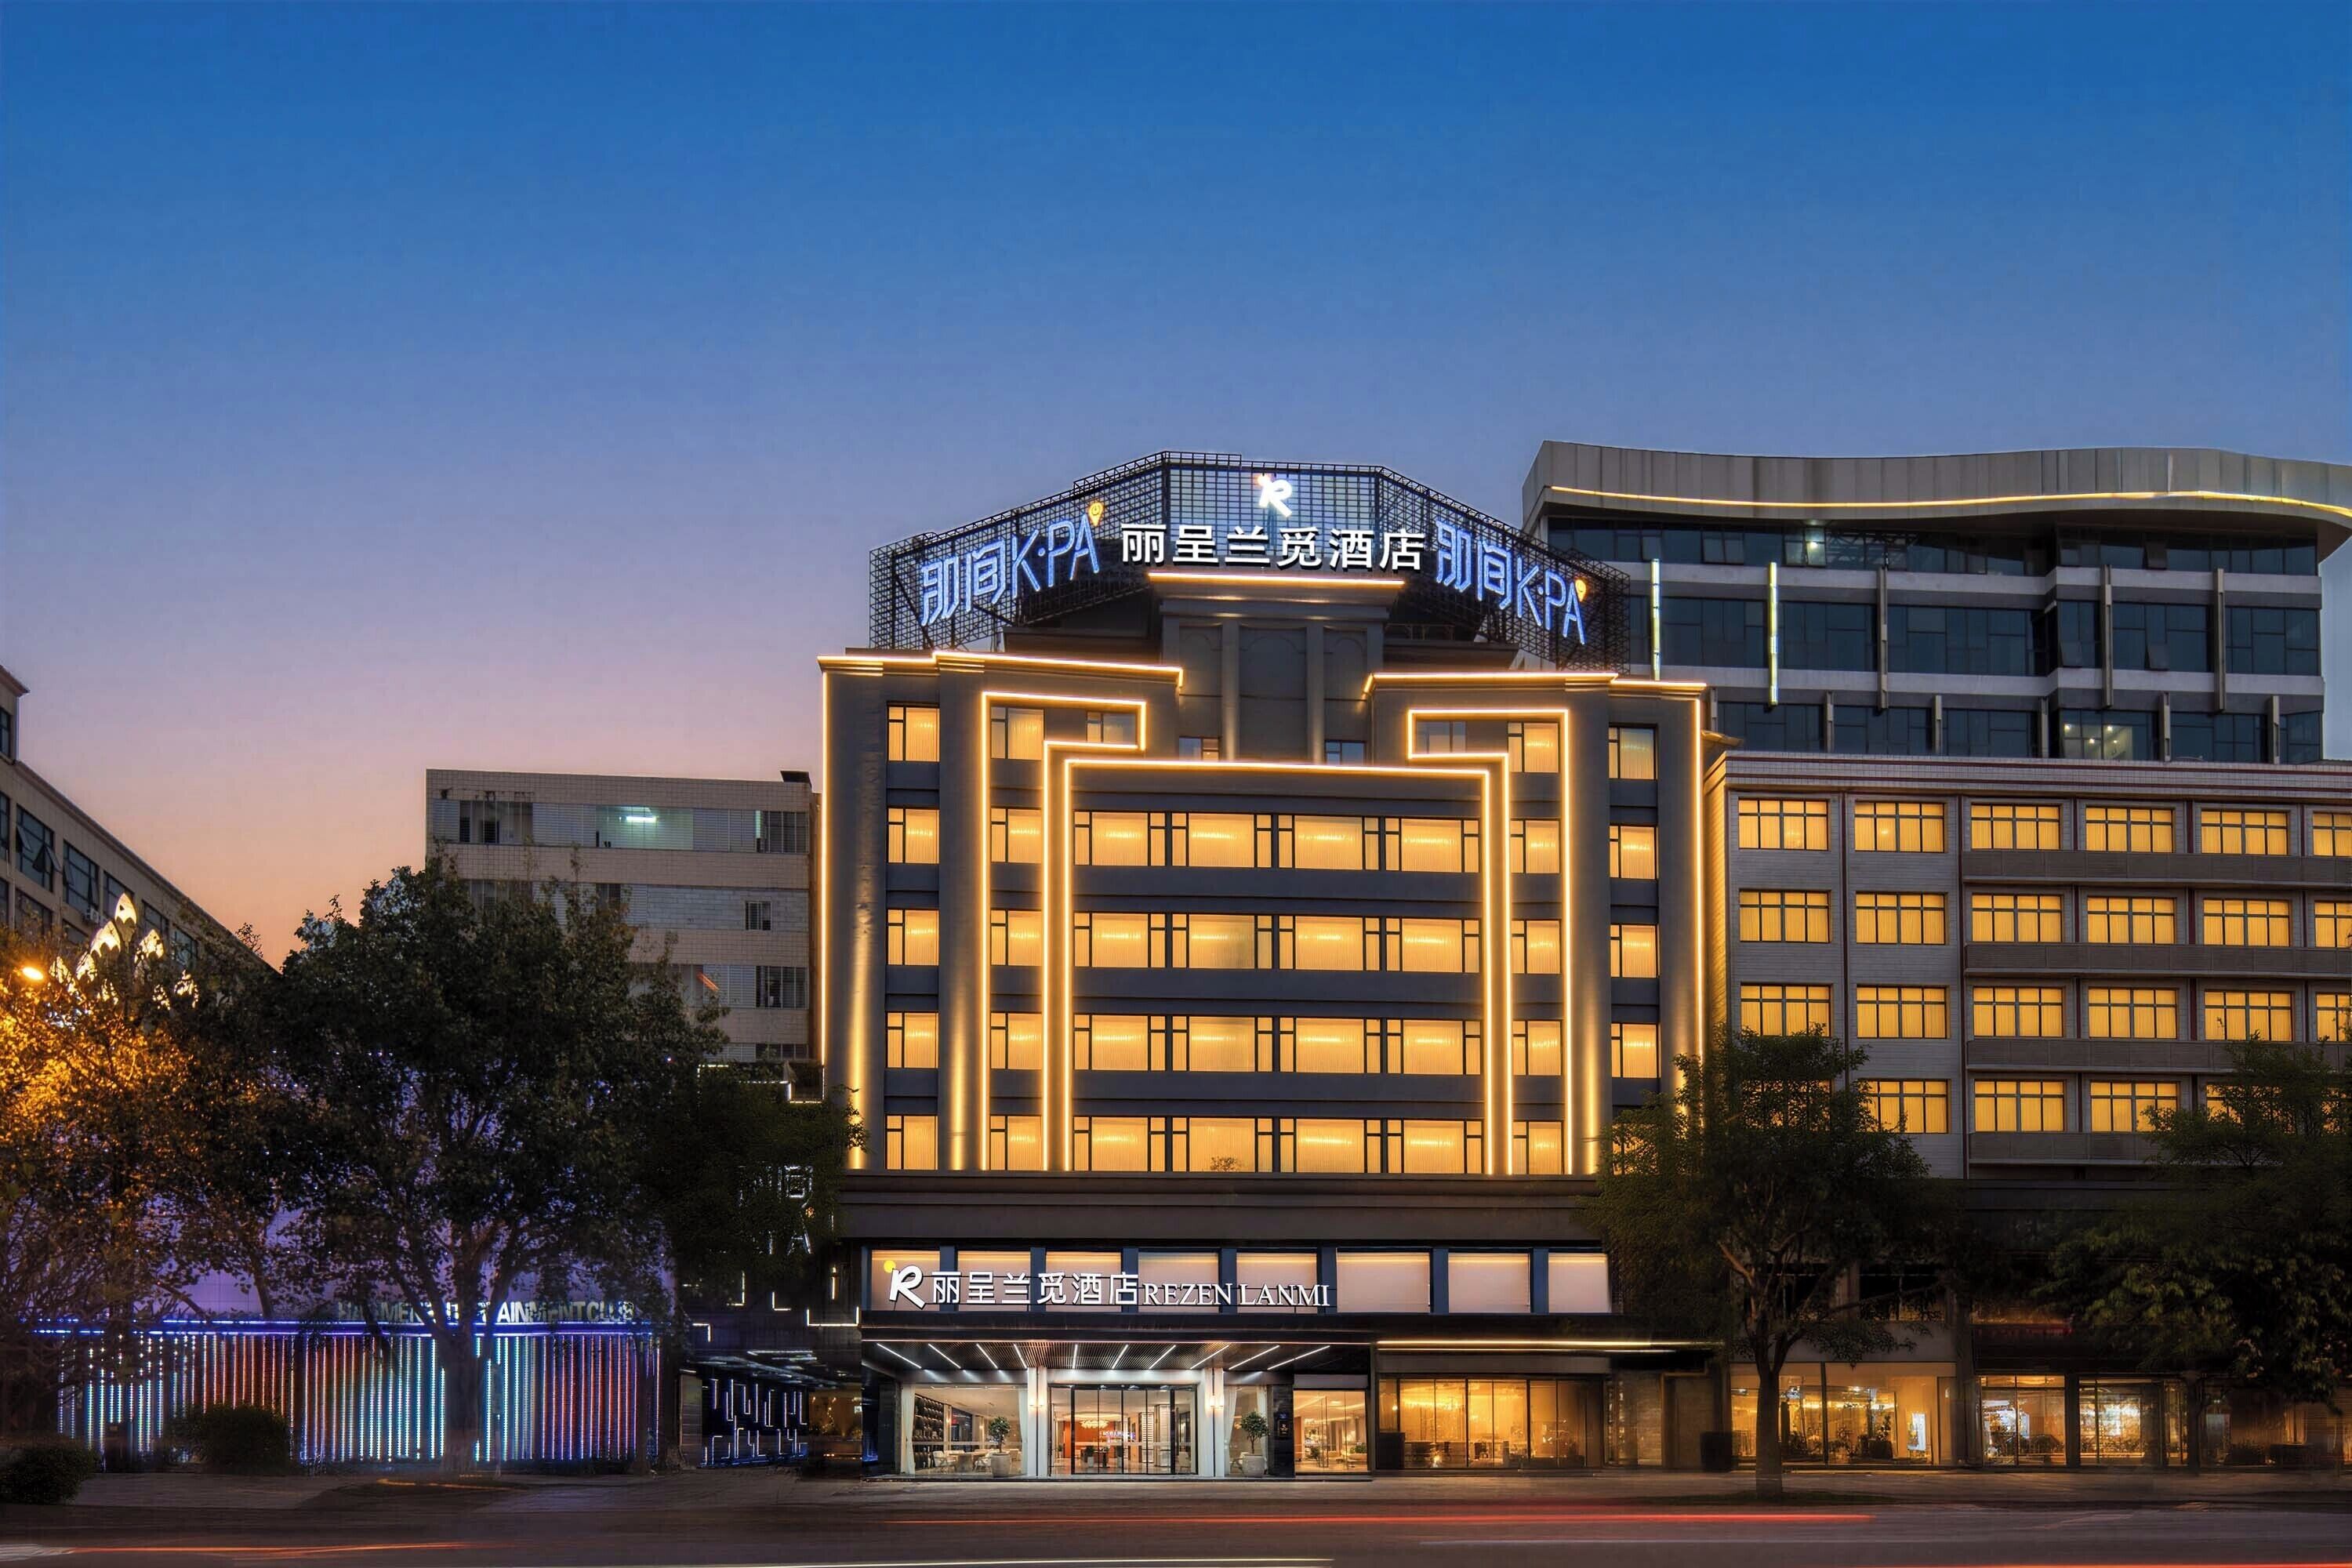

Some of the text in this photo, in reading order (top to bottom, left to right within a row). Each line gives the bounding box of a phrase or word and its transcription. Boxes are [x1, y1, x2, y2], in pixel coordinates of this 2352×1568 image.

[1120, 523, 1425, 571] 丽呈兰觅酒店
[931, 1271, 1139, 1305] 丽呈兰觅酒店
[1142, 1283, 1233, 1306] REZEN
[1239, 1283, 1330, 1307] LANMI
